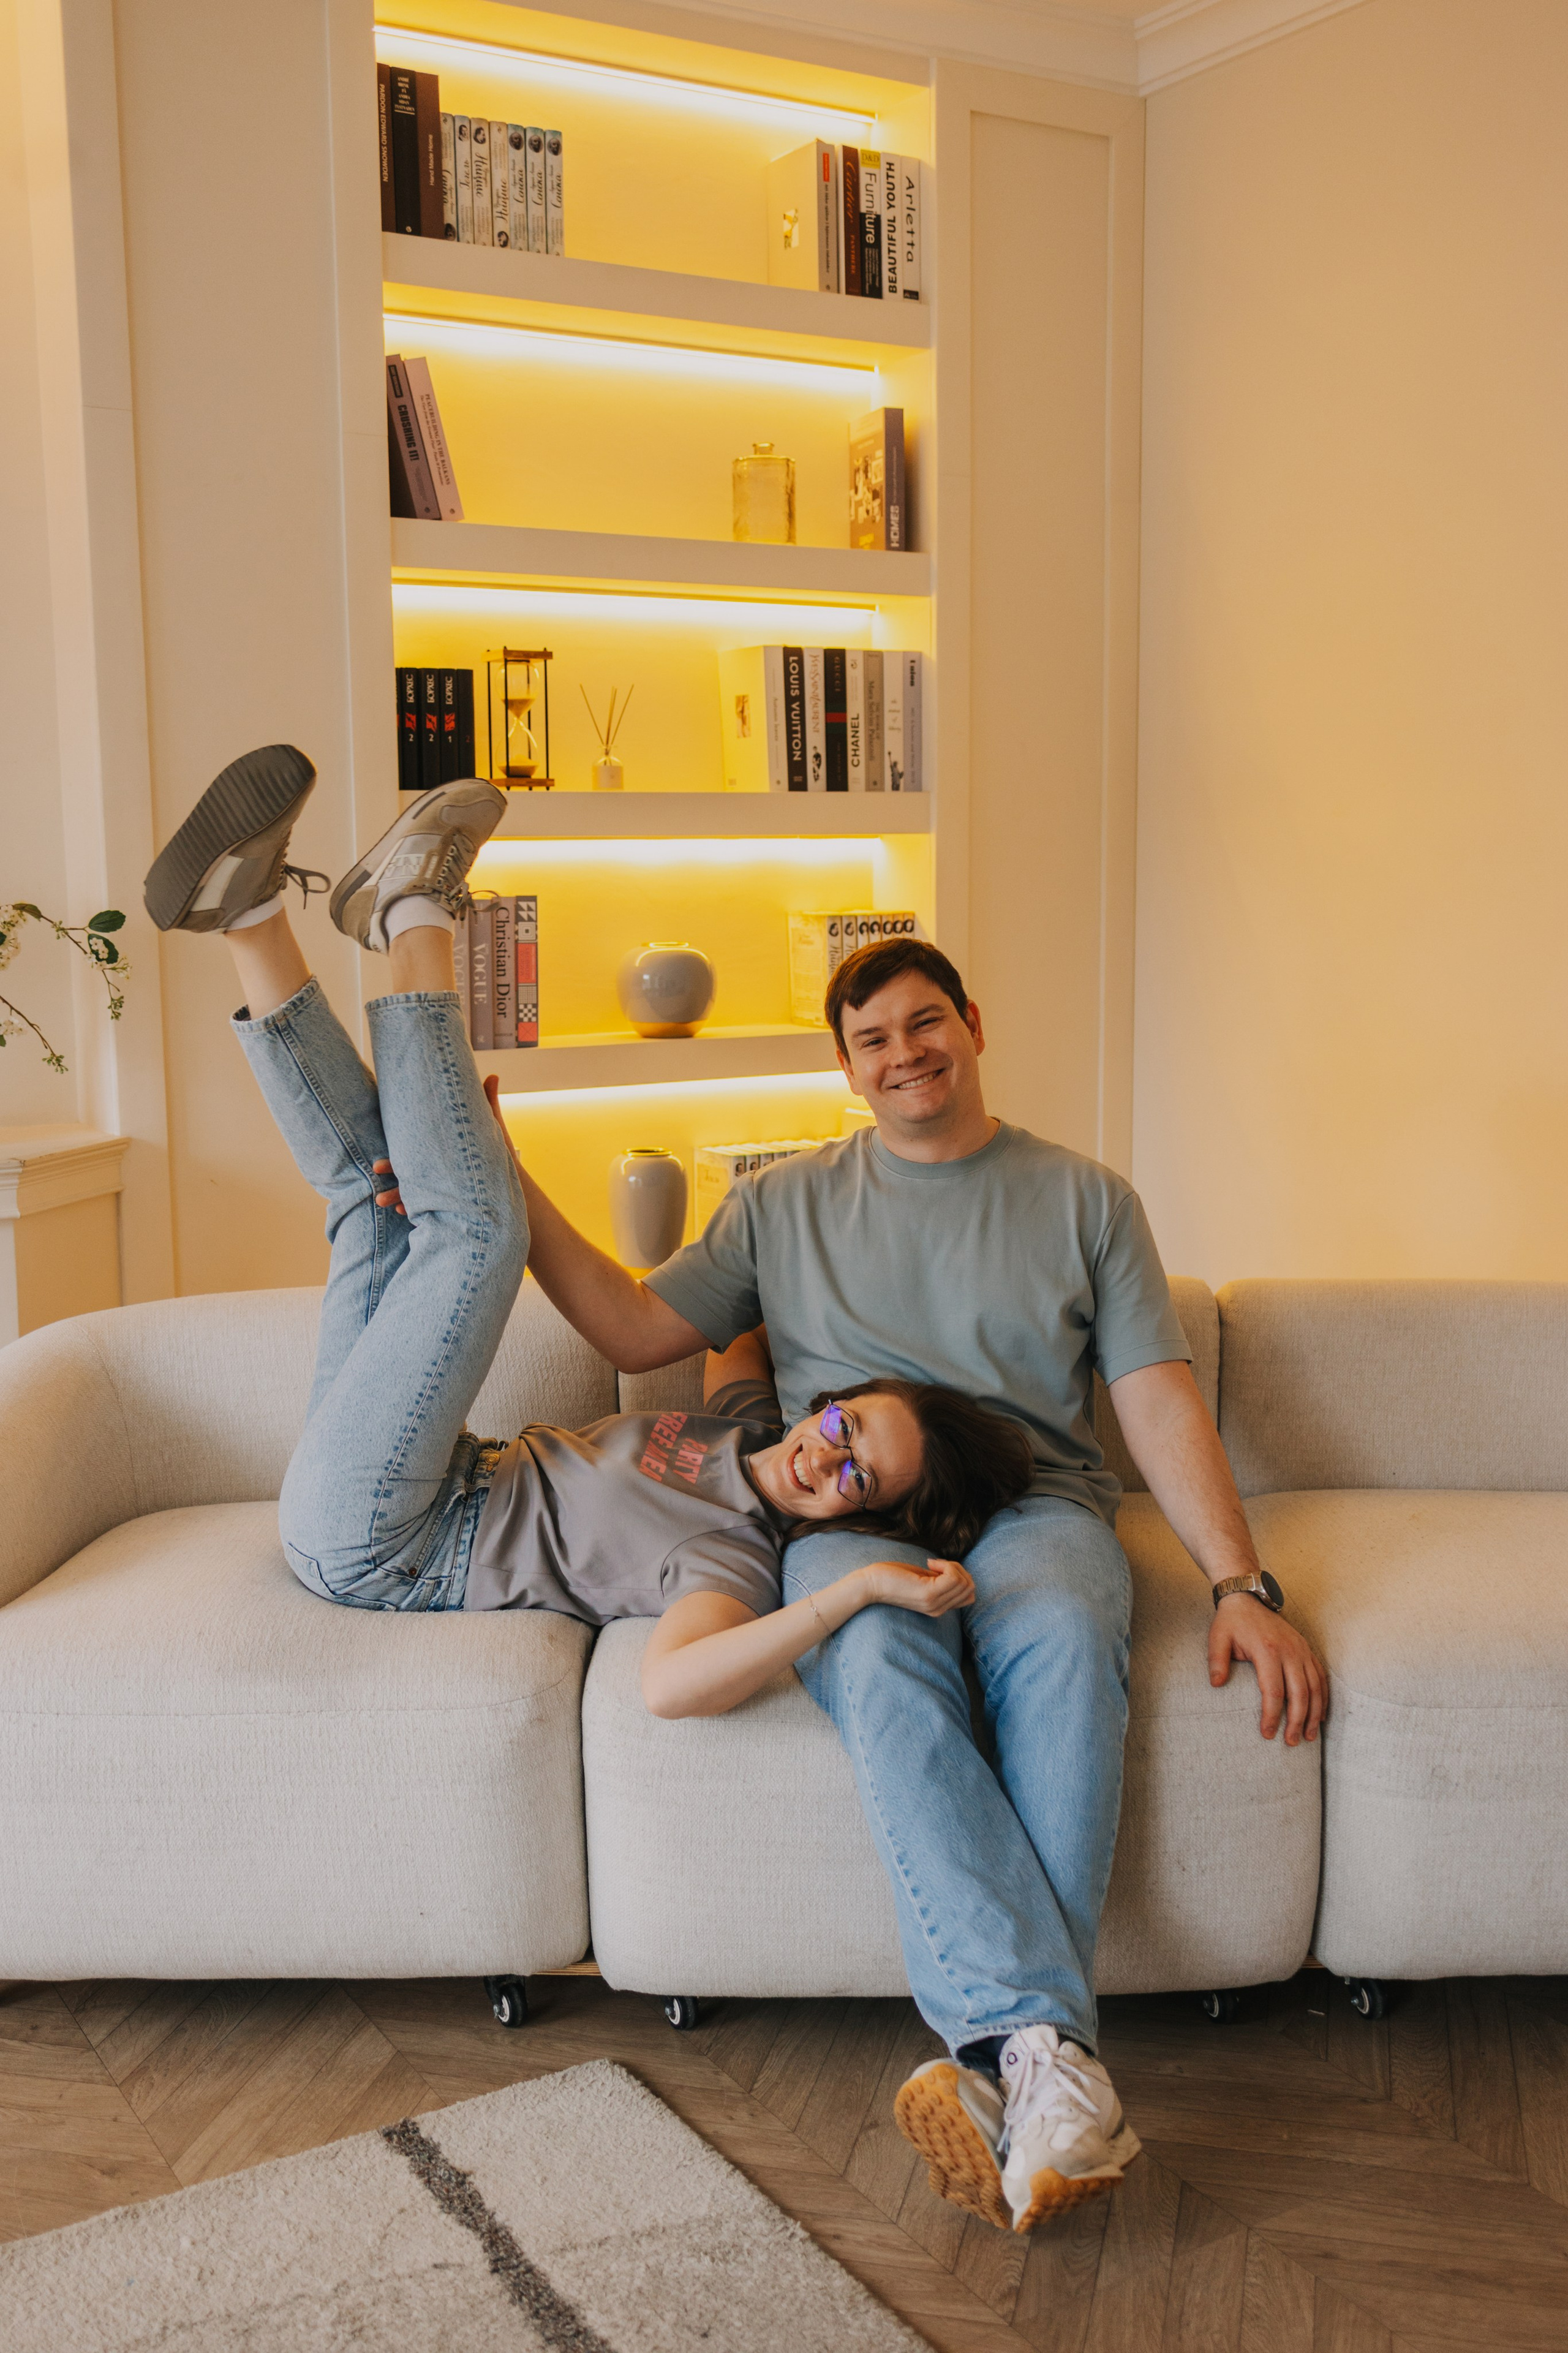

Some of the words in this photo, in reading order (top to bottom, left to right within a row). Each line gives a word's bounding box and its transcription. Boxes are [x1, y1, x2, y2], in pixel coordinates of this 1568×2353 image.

[459, 158, 470, 189] Гегель
[474, 152, 488, 198] Ницше
[513, 168, 524, 203] Сенека
[532, 170, 543, 206] Сенека
[551, 172, 562, 208] Сенека
[845, 161, 856, 219] Cartier
[886, 162, 895, 210] YOUTH
[495, 178, 508, 224] Ницше
[865, 172, 877, 244] Furniture
[905, 176, 916, 263] Arletta
[887, 216, 897, 294] BEAUTIFUL
[398, 404, 415, 450] CRUSHING
[425, 394, 439, 440] PEACEBUILDING
[440, 459, 451, 485] BALKANS
[890, 505, 900, 548] HOMES
[405, 674, 415, 703] БОРХЕС
[426, 674, 435, 703] БОРХЕС
[790, 655, 799, 697] LOUIS
[791, 702, 802, 761] VUITTON
[496, 907, 510, 978] Christian
[473, 943, 487, 1005] VOGUE
[496, 984, 511, 1018] Dior
[650, 1411, 688, 1449] FREE
